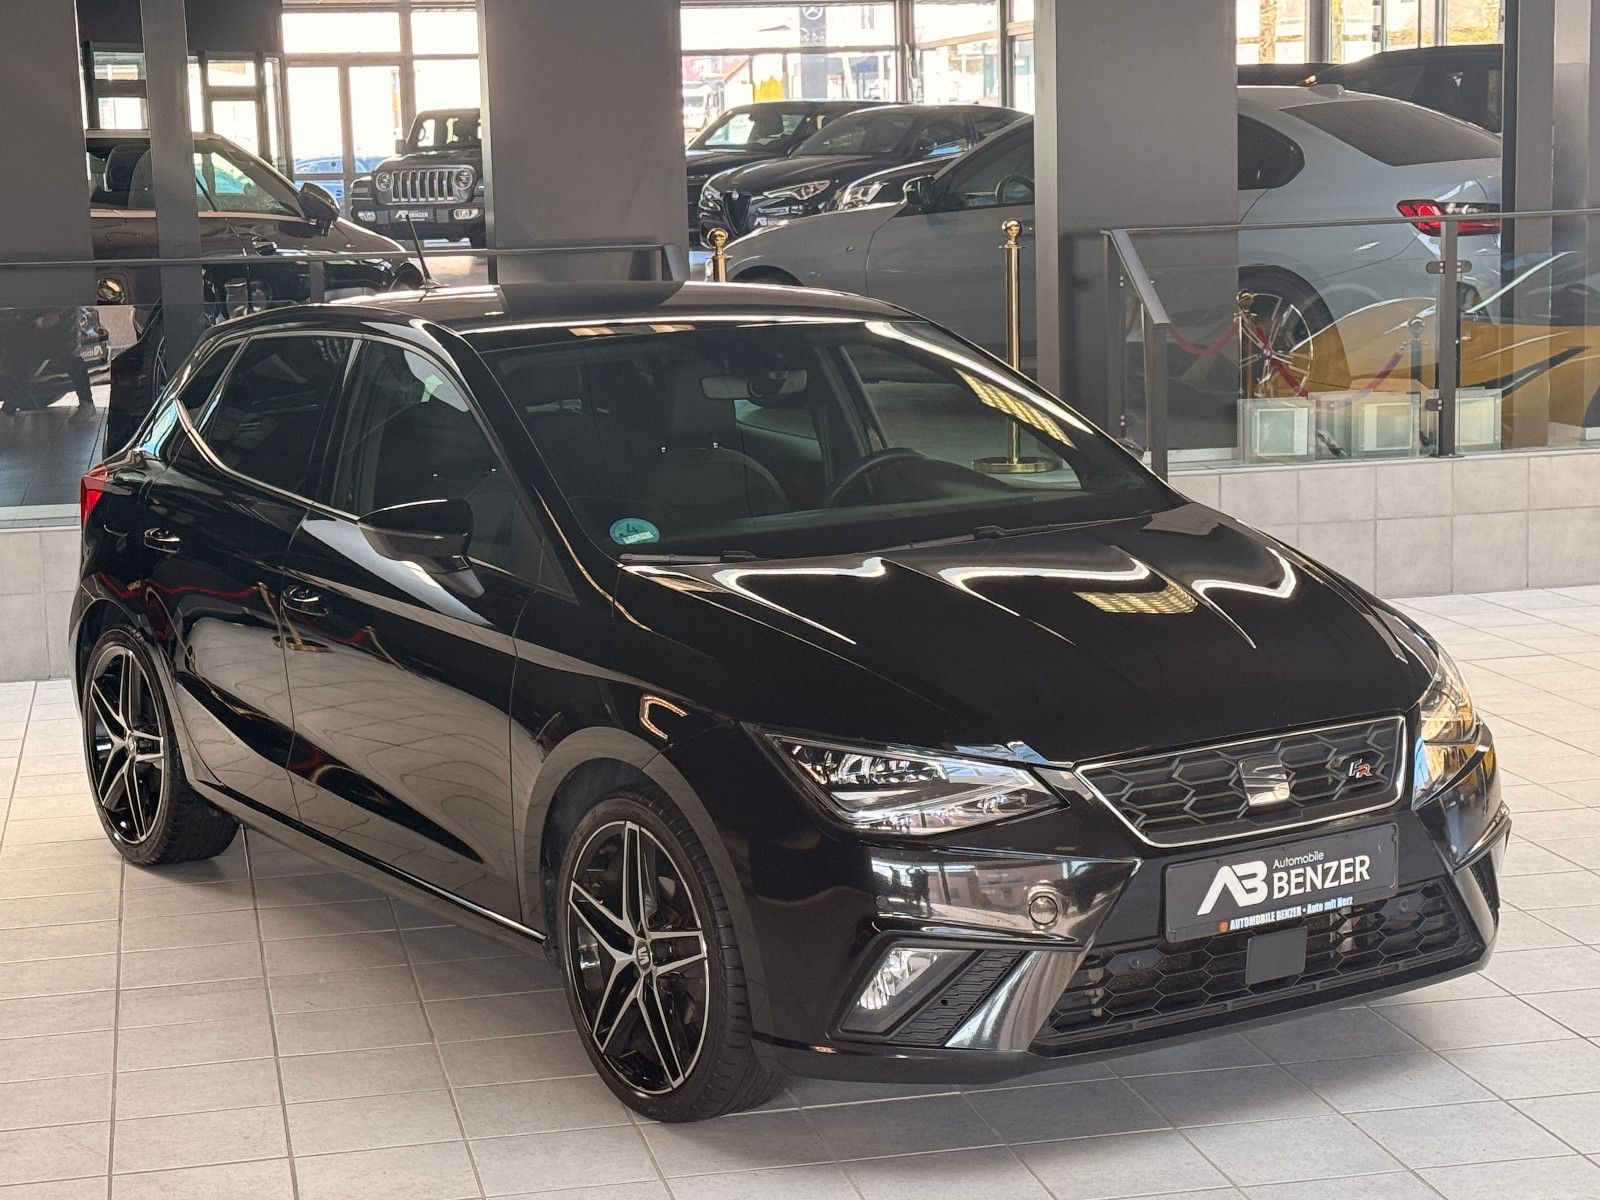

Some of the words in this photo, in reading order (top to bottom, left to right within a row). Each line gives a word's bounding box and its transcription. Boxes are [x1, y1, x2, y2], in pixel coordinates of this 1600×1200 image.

[625, 522, 638, 534] 4
[1273, 850, 1324, 869] Automobile
[1196, 859, 1268, 916] AB
[1272, 854, 1371, 900] BENZER
[1230, 912, 1275, 931] AUTOMOBILE
[1275, 905, 1302, 921] BENZER
